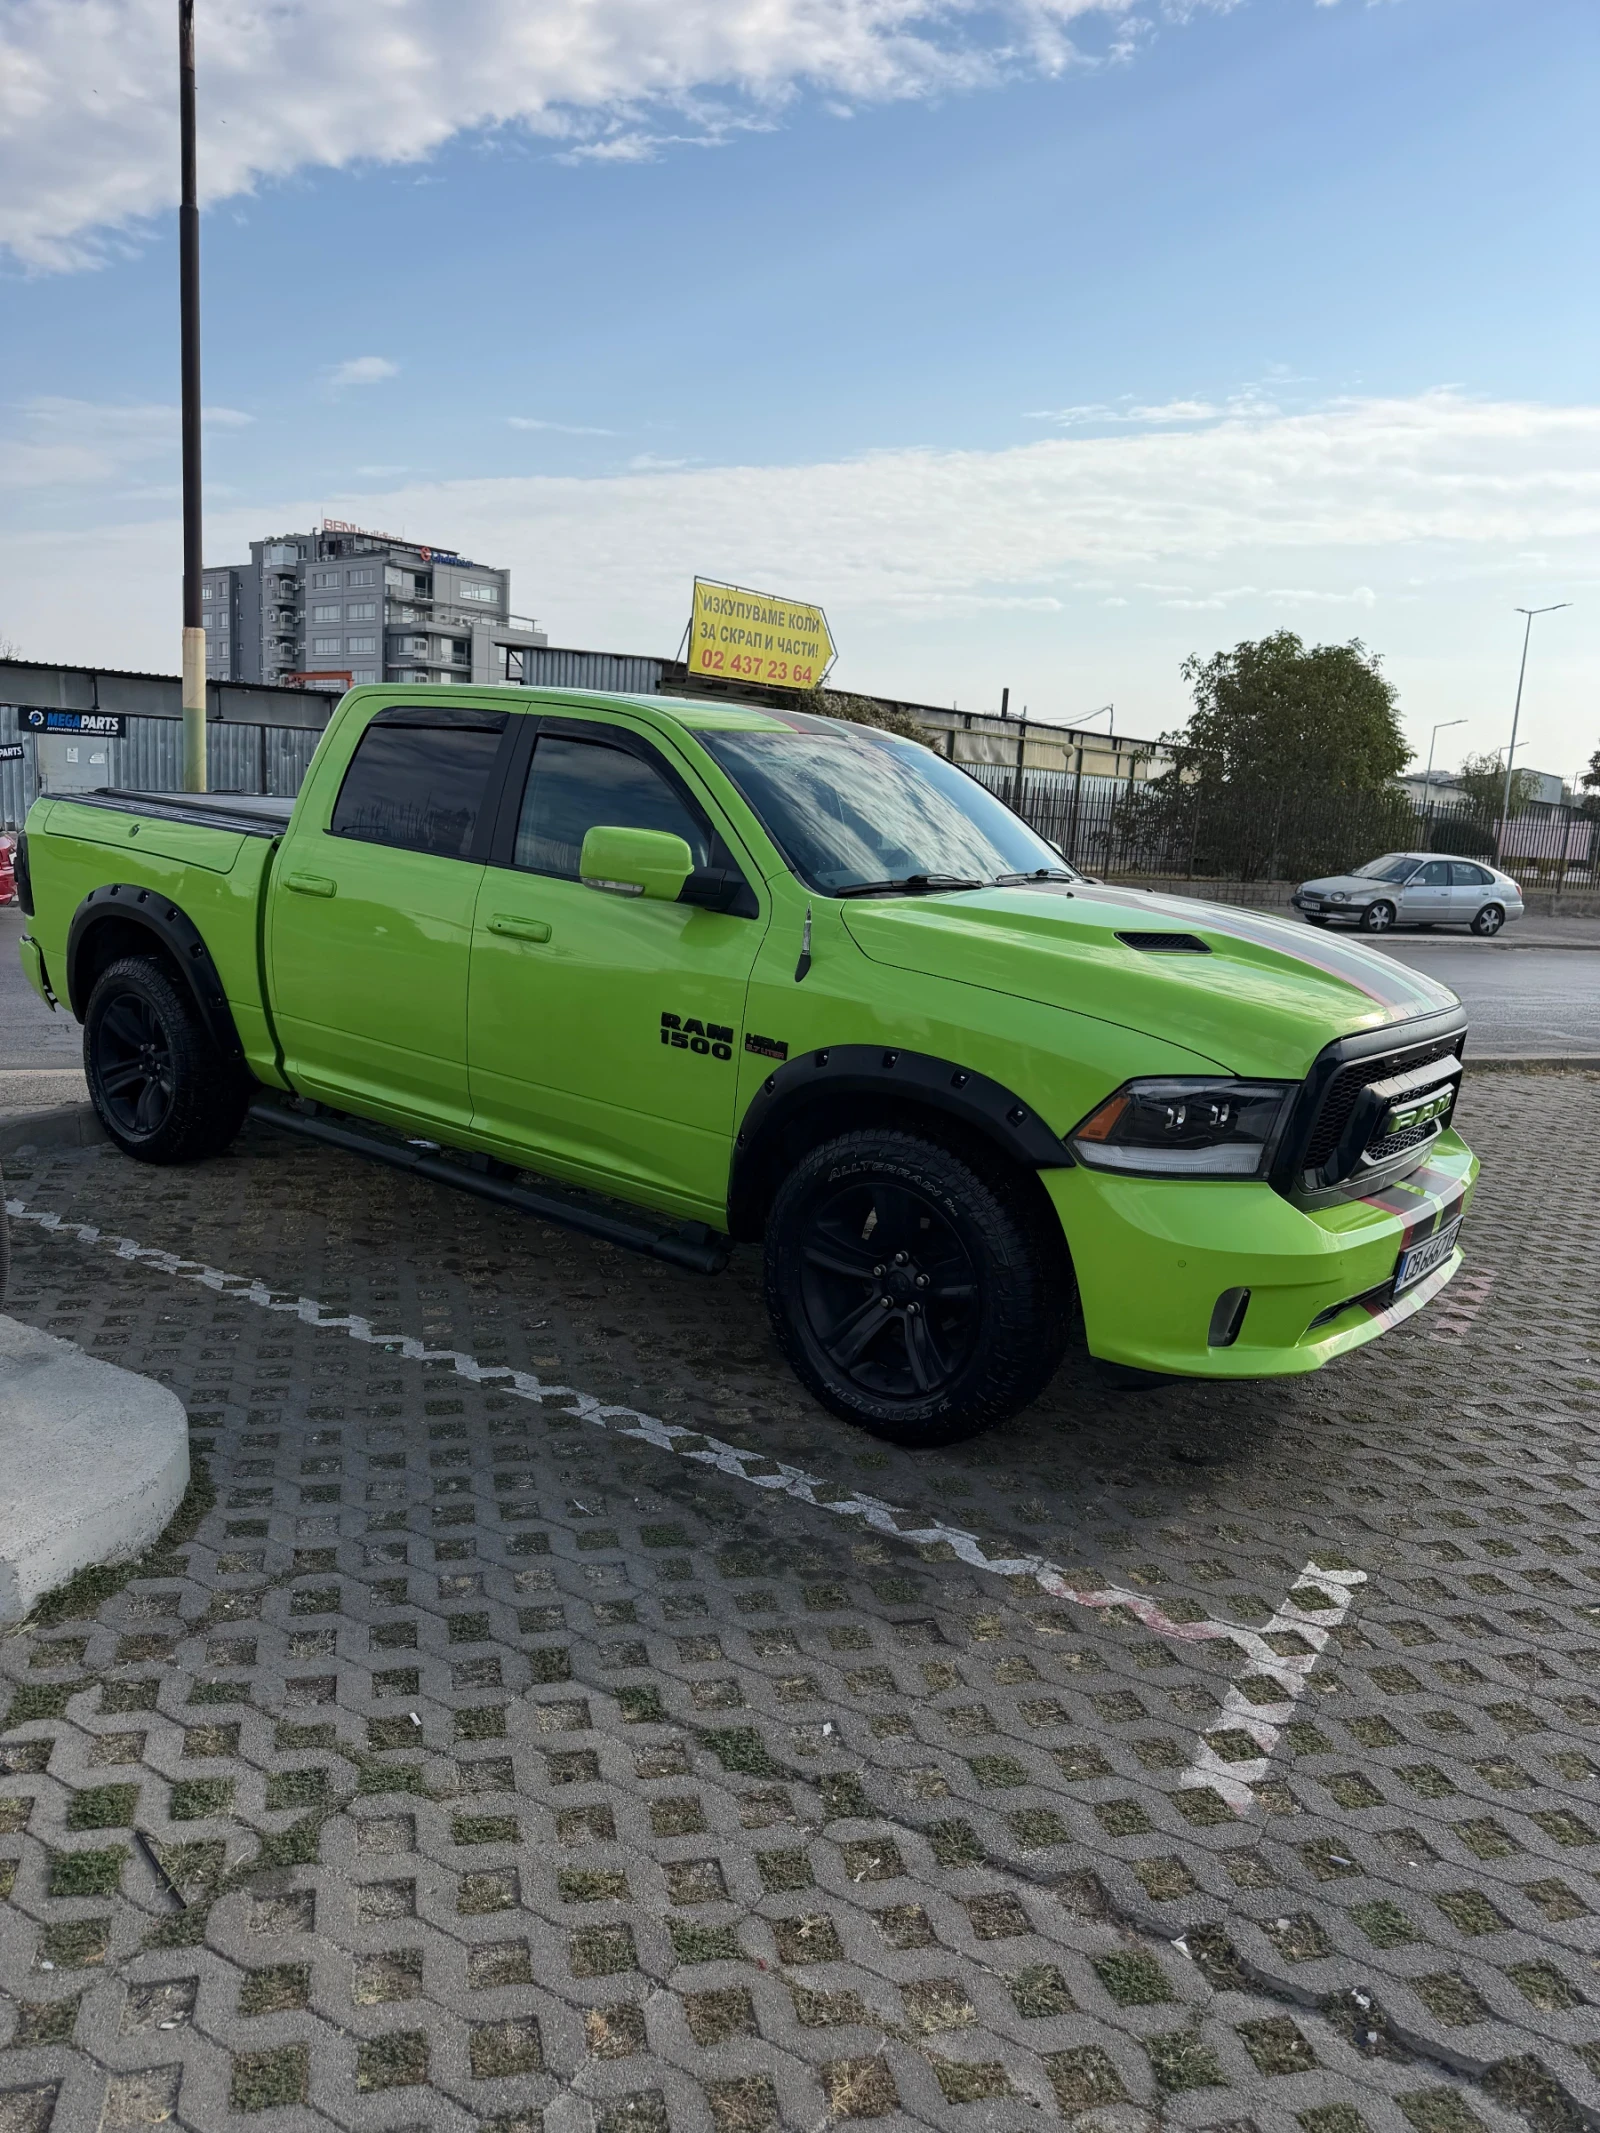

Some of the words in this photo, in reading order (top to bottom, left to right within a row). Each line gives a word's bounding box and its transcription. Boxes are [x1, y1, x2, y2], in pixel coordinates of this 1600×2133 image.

[703, 594, 785, 627] ИЗКУПУВАМЕ
[788, 613, 820, 634] КОЛИ
[700, 621, 716, 641] ЗА
[720, 626, 762, 649] СКРАП
[764, 634, 773, 651] И
[777, 637, 819, 659] ЧАСТИ!
[701, 649, 724, 670] 02
[730, 654, 763, 675] 437
[767, 660, 787, 680] 23
[793, 664, 812, 684] 64
[660, 1028, 732, 1061] 1500
[661, 1011, 734, 1044] RAM
[1387, 1092, 1453, 1133] RAM
